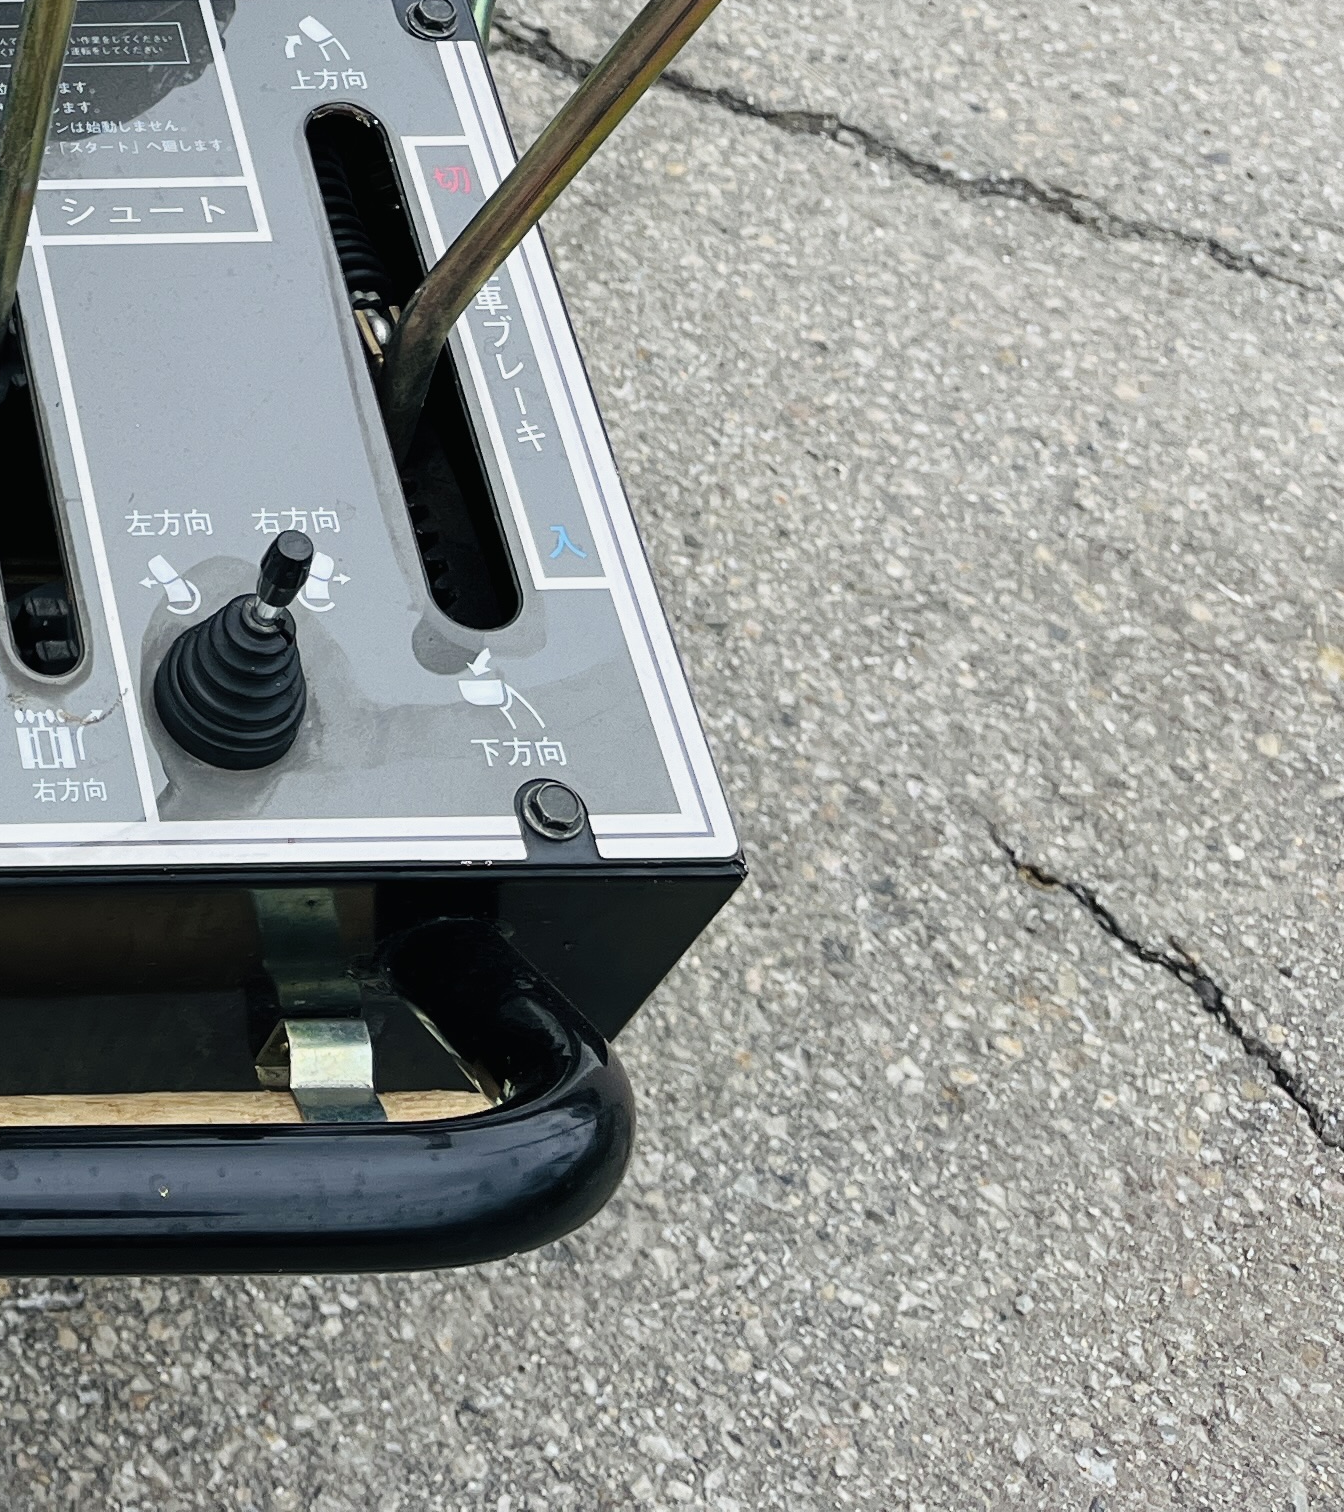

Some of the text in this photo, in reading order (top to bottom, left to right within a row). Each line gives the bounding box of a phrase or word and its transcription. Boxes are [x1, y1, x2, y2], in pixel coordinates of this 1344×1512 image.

[291, 68, 368, 91] 上方向
[433, 166, 472, 194] 切
[61, 196, 226, 227] シュート
[475, 276, 546, 452] 車ブレーキ
[124, 509, 213, 537] 左方向
[251, 506, 341, 534] 右方向
[549, 525, 587, 559] 入
[470, 736, 568, 768] 下方向
[32, 777, 108, 803] 右方向
